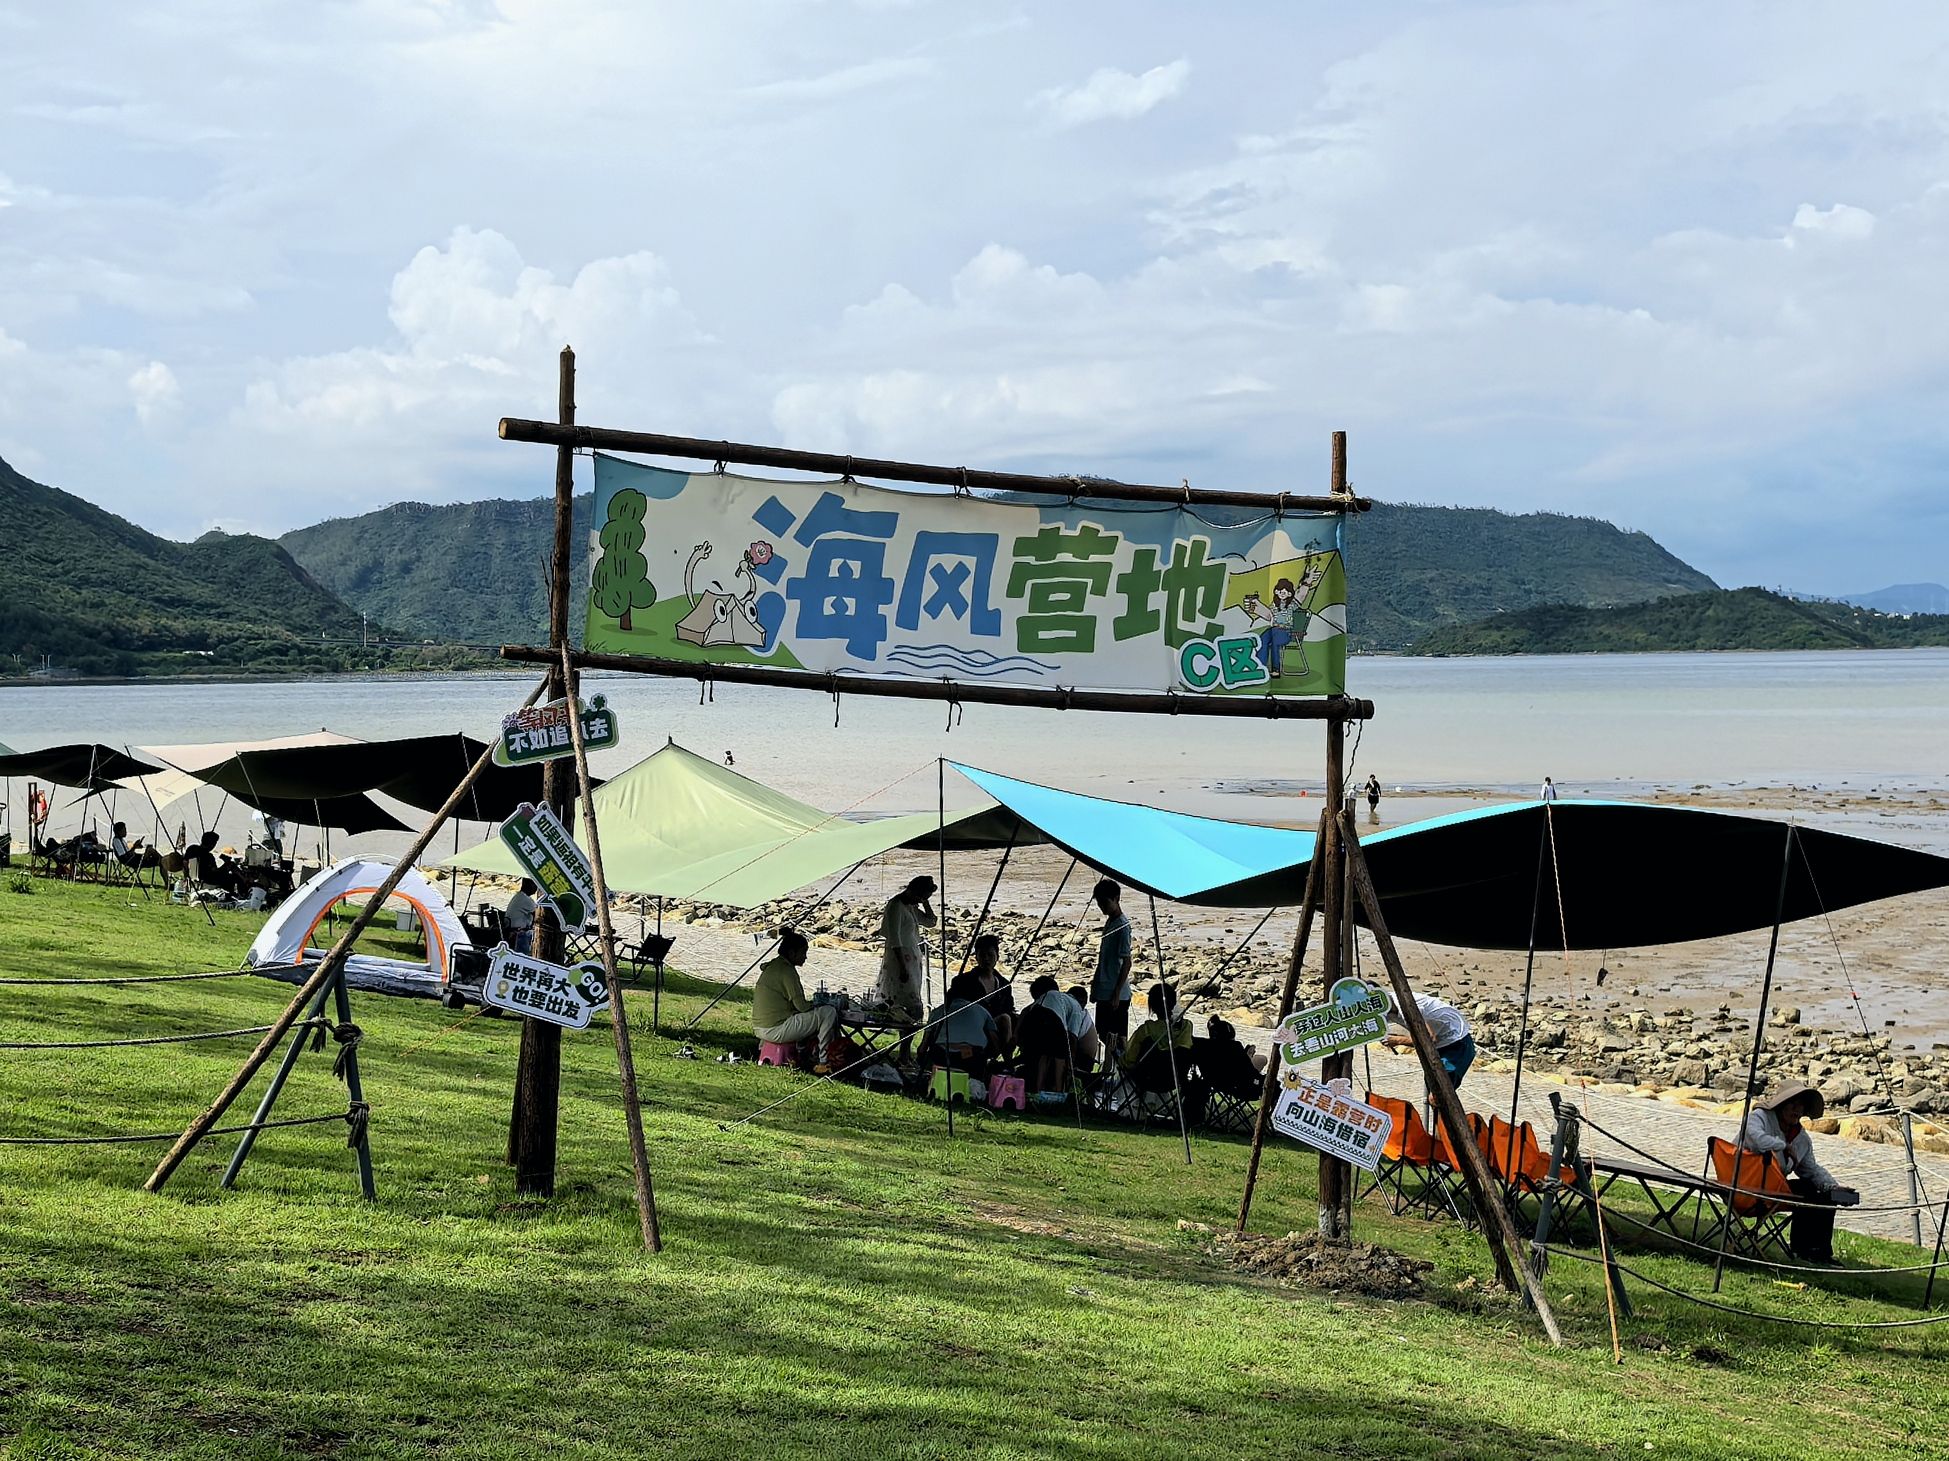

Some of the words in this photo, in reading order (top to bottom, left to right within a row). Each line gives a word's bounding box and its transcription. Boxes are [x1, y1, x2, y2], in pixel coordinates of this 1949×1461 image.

[752, 491, 1227, 661] 海风营地
[1180, 637, 1266, 687] C区
[512, 825, 571, 899] 一定是露营
[502, 961, 571, 997] 世界再大
[581, 971, 608, 1003] GO!
[511, 985, 580, 1020] 也要出发
[1293, 995, 1383, 1034] 穿过人山人海
[1289, 1018, 1380, 1058] 去看山河大海
[1285, 1101, 1371, 1149] 向山海借宿
[1298, 1087, 1383, 1134] 正是露营时
